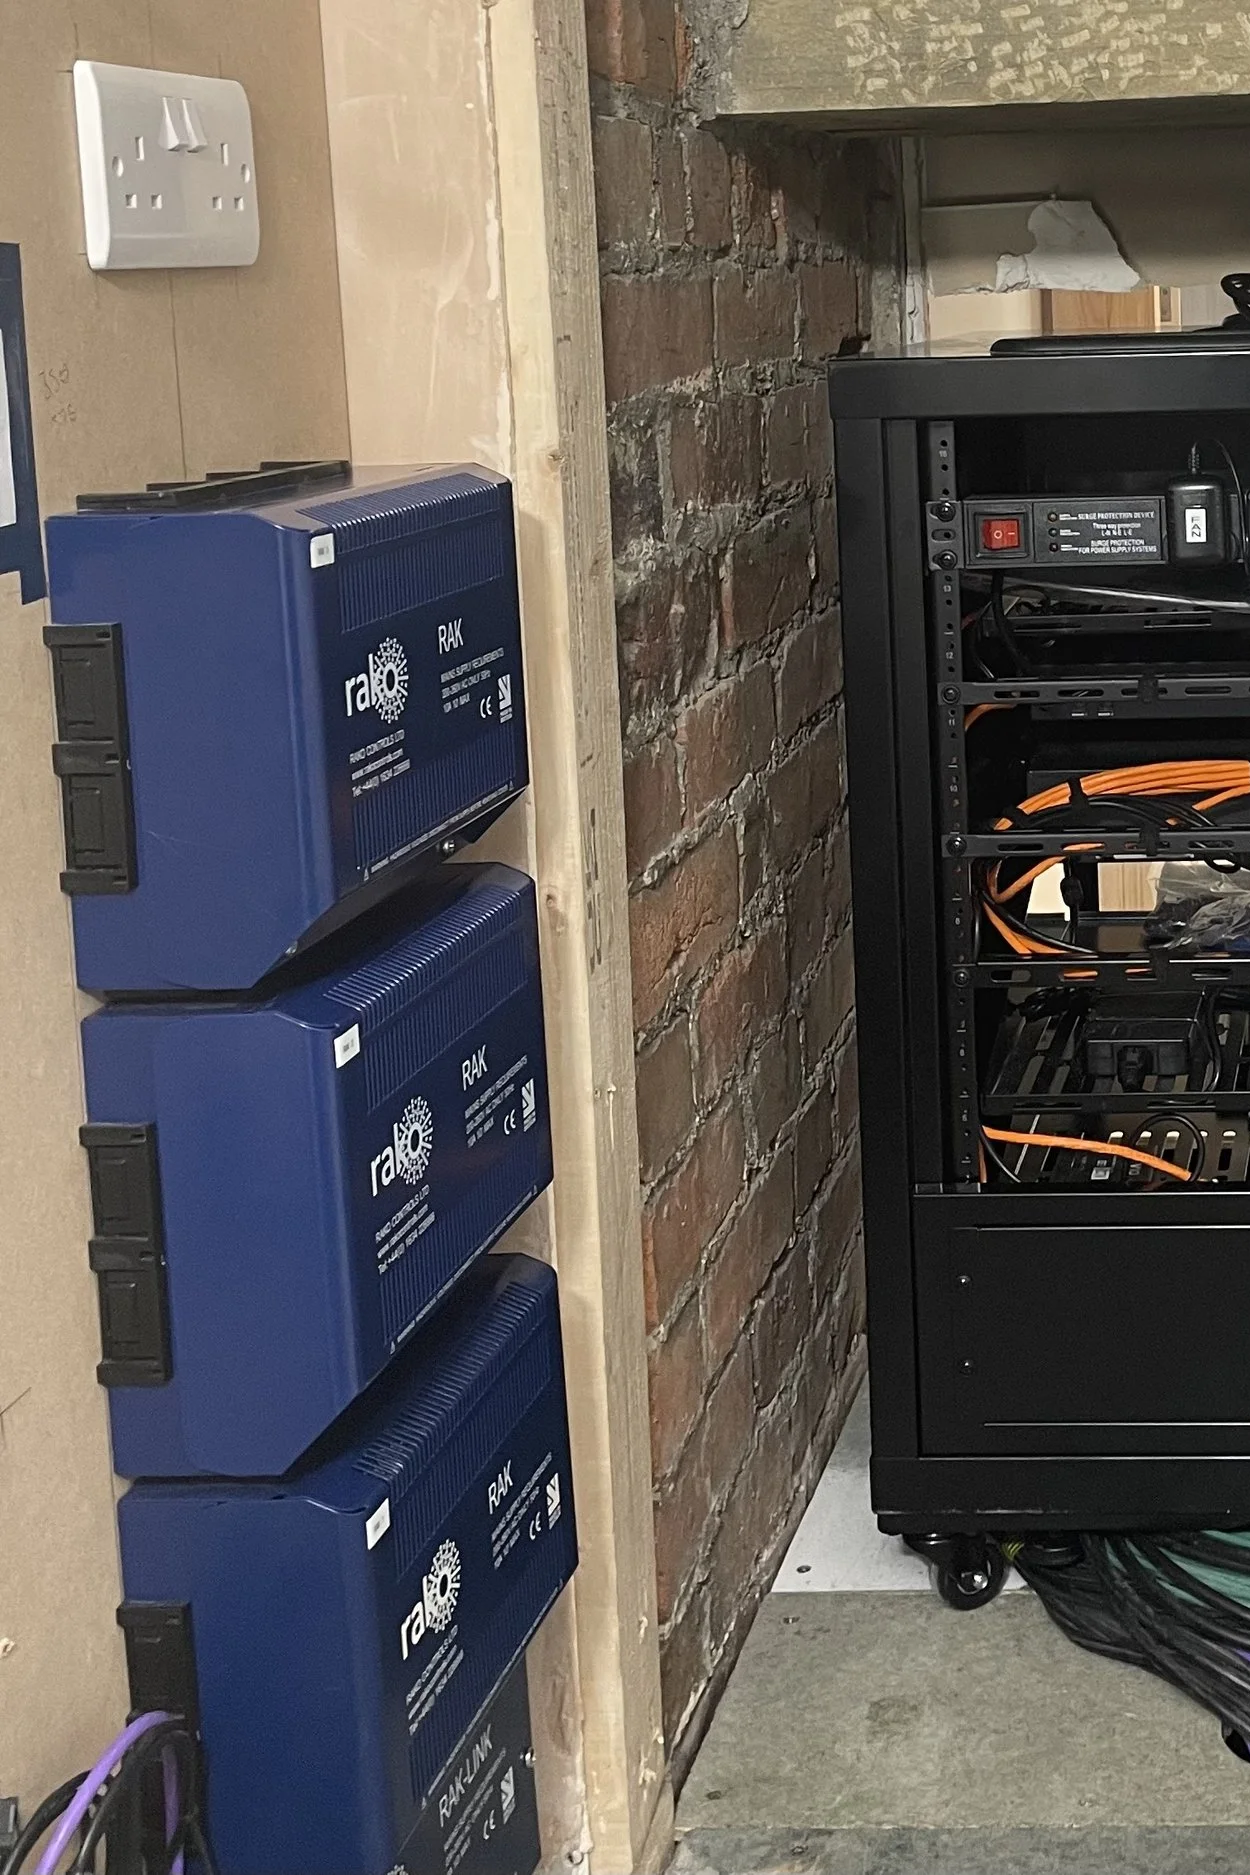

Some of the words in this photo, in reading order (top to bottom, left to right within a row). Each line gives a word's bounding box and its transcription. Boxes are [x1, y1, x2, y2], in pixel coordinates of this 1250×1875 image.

[1078, 512, 1097, 520] SURGE
[1097, 512, 1133, 520] PROTECTION
[1133, 510, 1155, 519] DEVICE
[1191, 516, 1202, 538] FAN
[1078, 547, 1090, 555] FOR
[1090, 546, 1110, 554] POWER
[1131, 545, 1157, 553] SYSTEMS
[1090, 539, 1110, 547] SURGE
[438, 617, 464, 655] RAK
[344, 637, 410, 724] rako
[462, 1044, 488, 1092] RAK
[370, 1096, 434, 1197] rako
[391, 1194, 420, 1229] CONTROLS
[488, 1459, 513, 1515] RAK
[400, 1538, 461, 1660] rako
[439, 1723, 492, 1828] RAK-LINK
